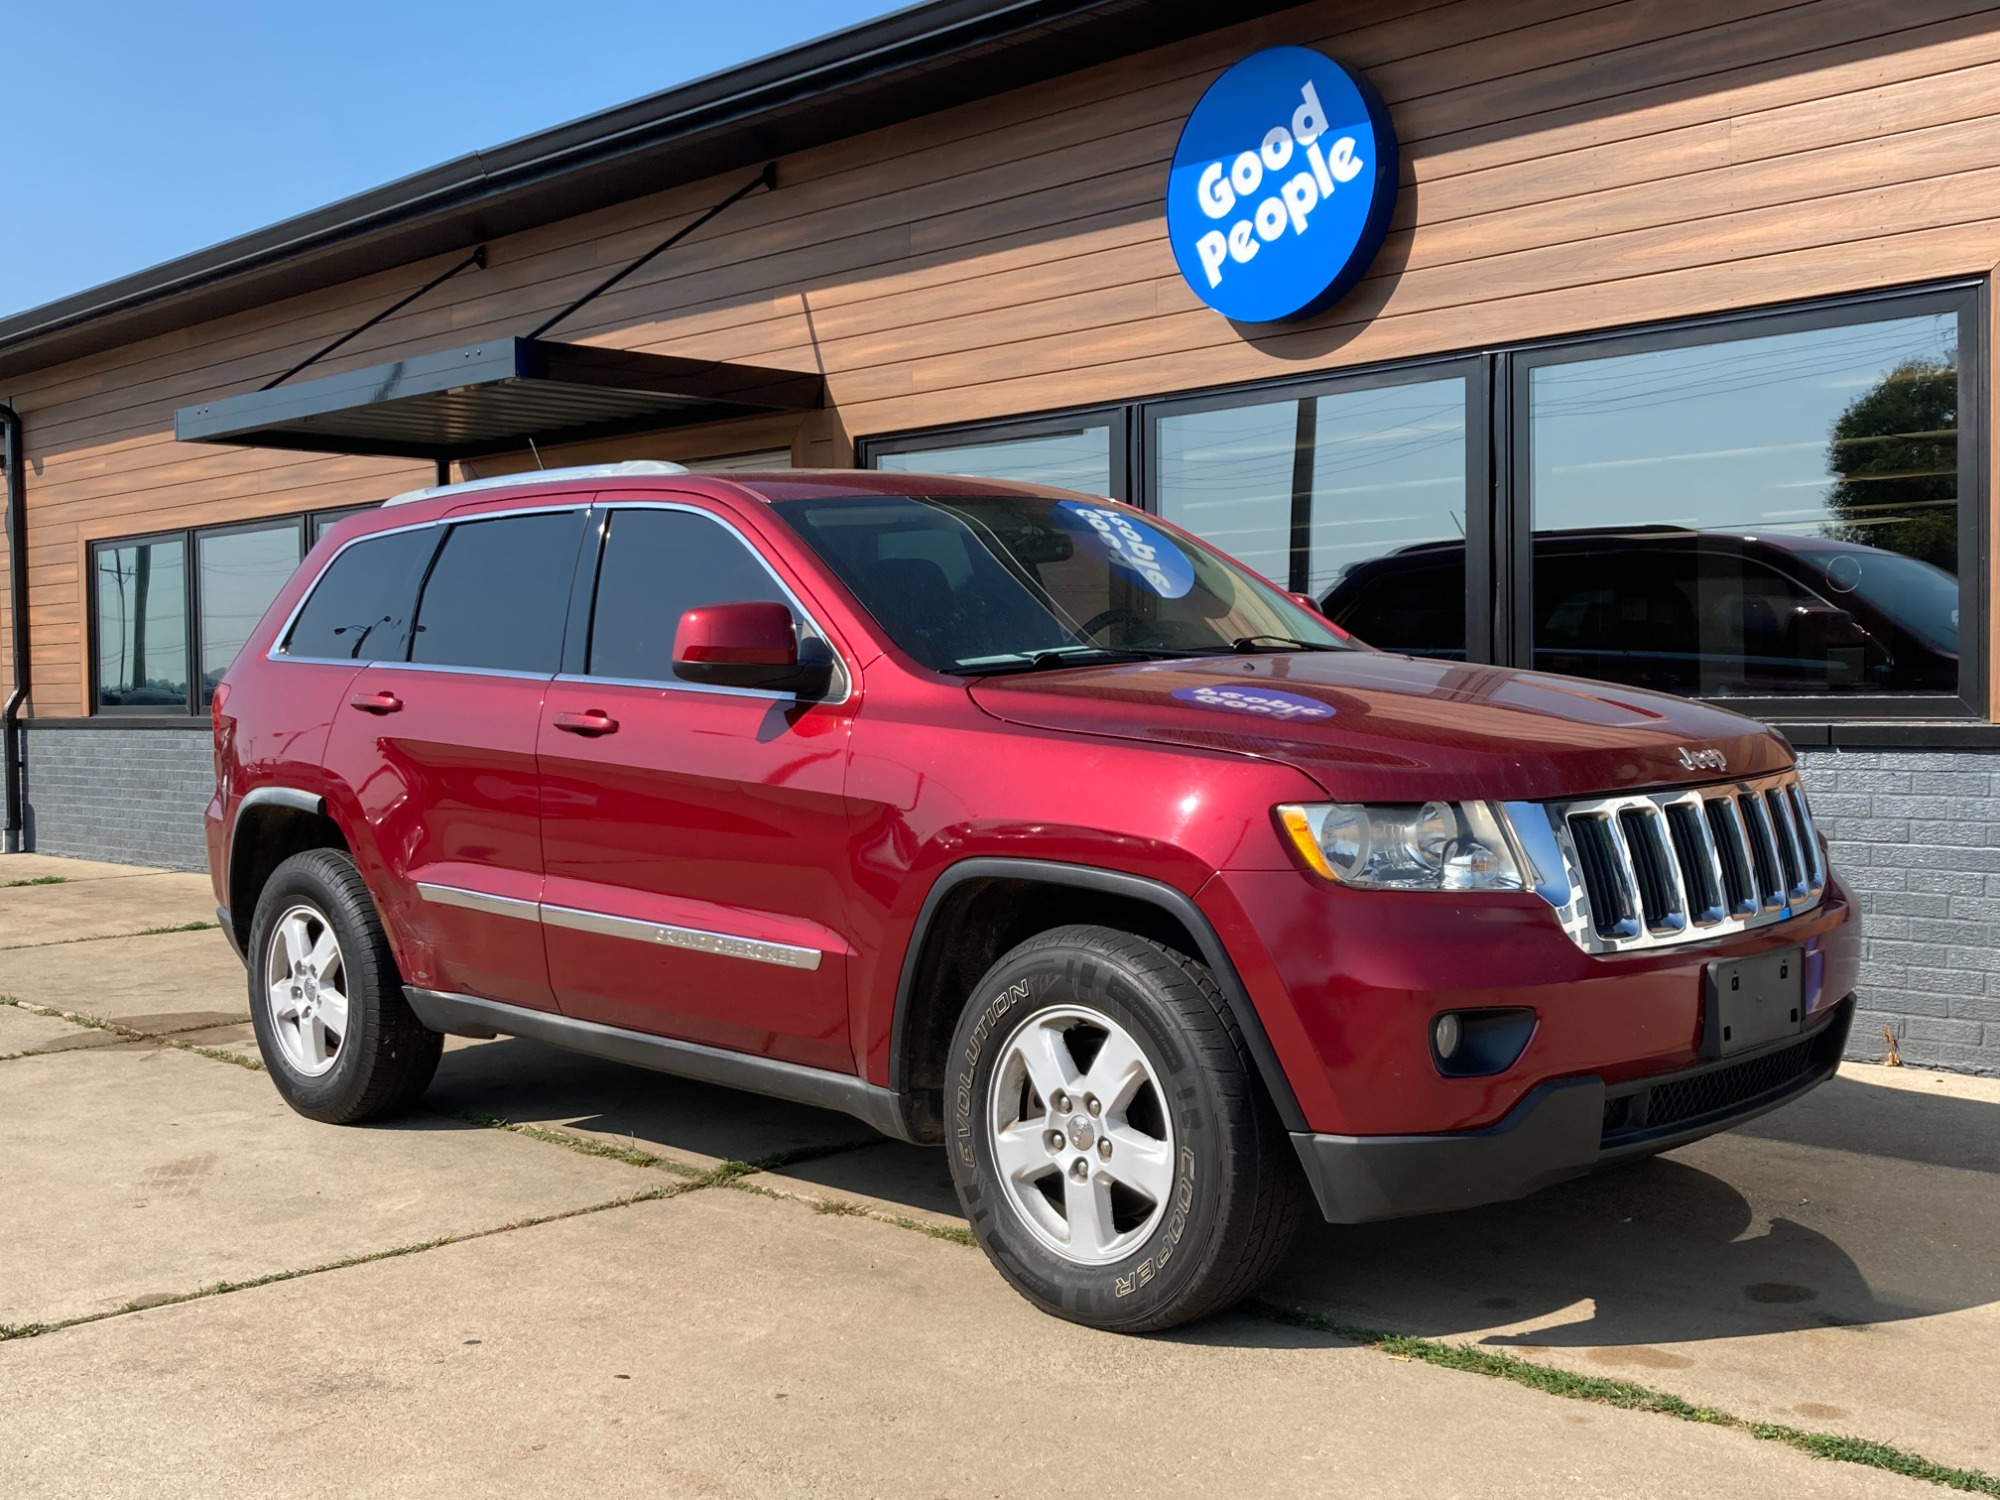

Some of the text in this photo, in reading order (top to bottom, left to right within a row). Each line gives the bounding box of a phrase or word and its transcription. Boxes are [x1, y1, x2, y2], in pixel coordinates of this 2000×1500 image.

[1195, 136, 1364, 290] People
[1198, 79, 1329, 219] Good
[1678, 746, 1728, 772] Jeep
[955, 977, 1032, 1169] EVOLUTION
[1115, 1145, 1196, 1298] COOPER
